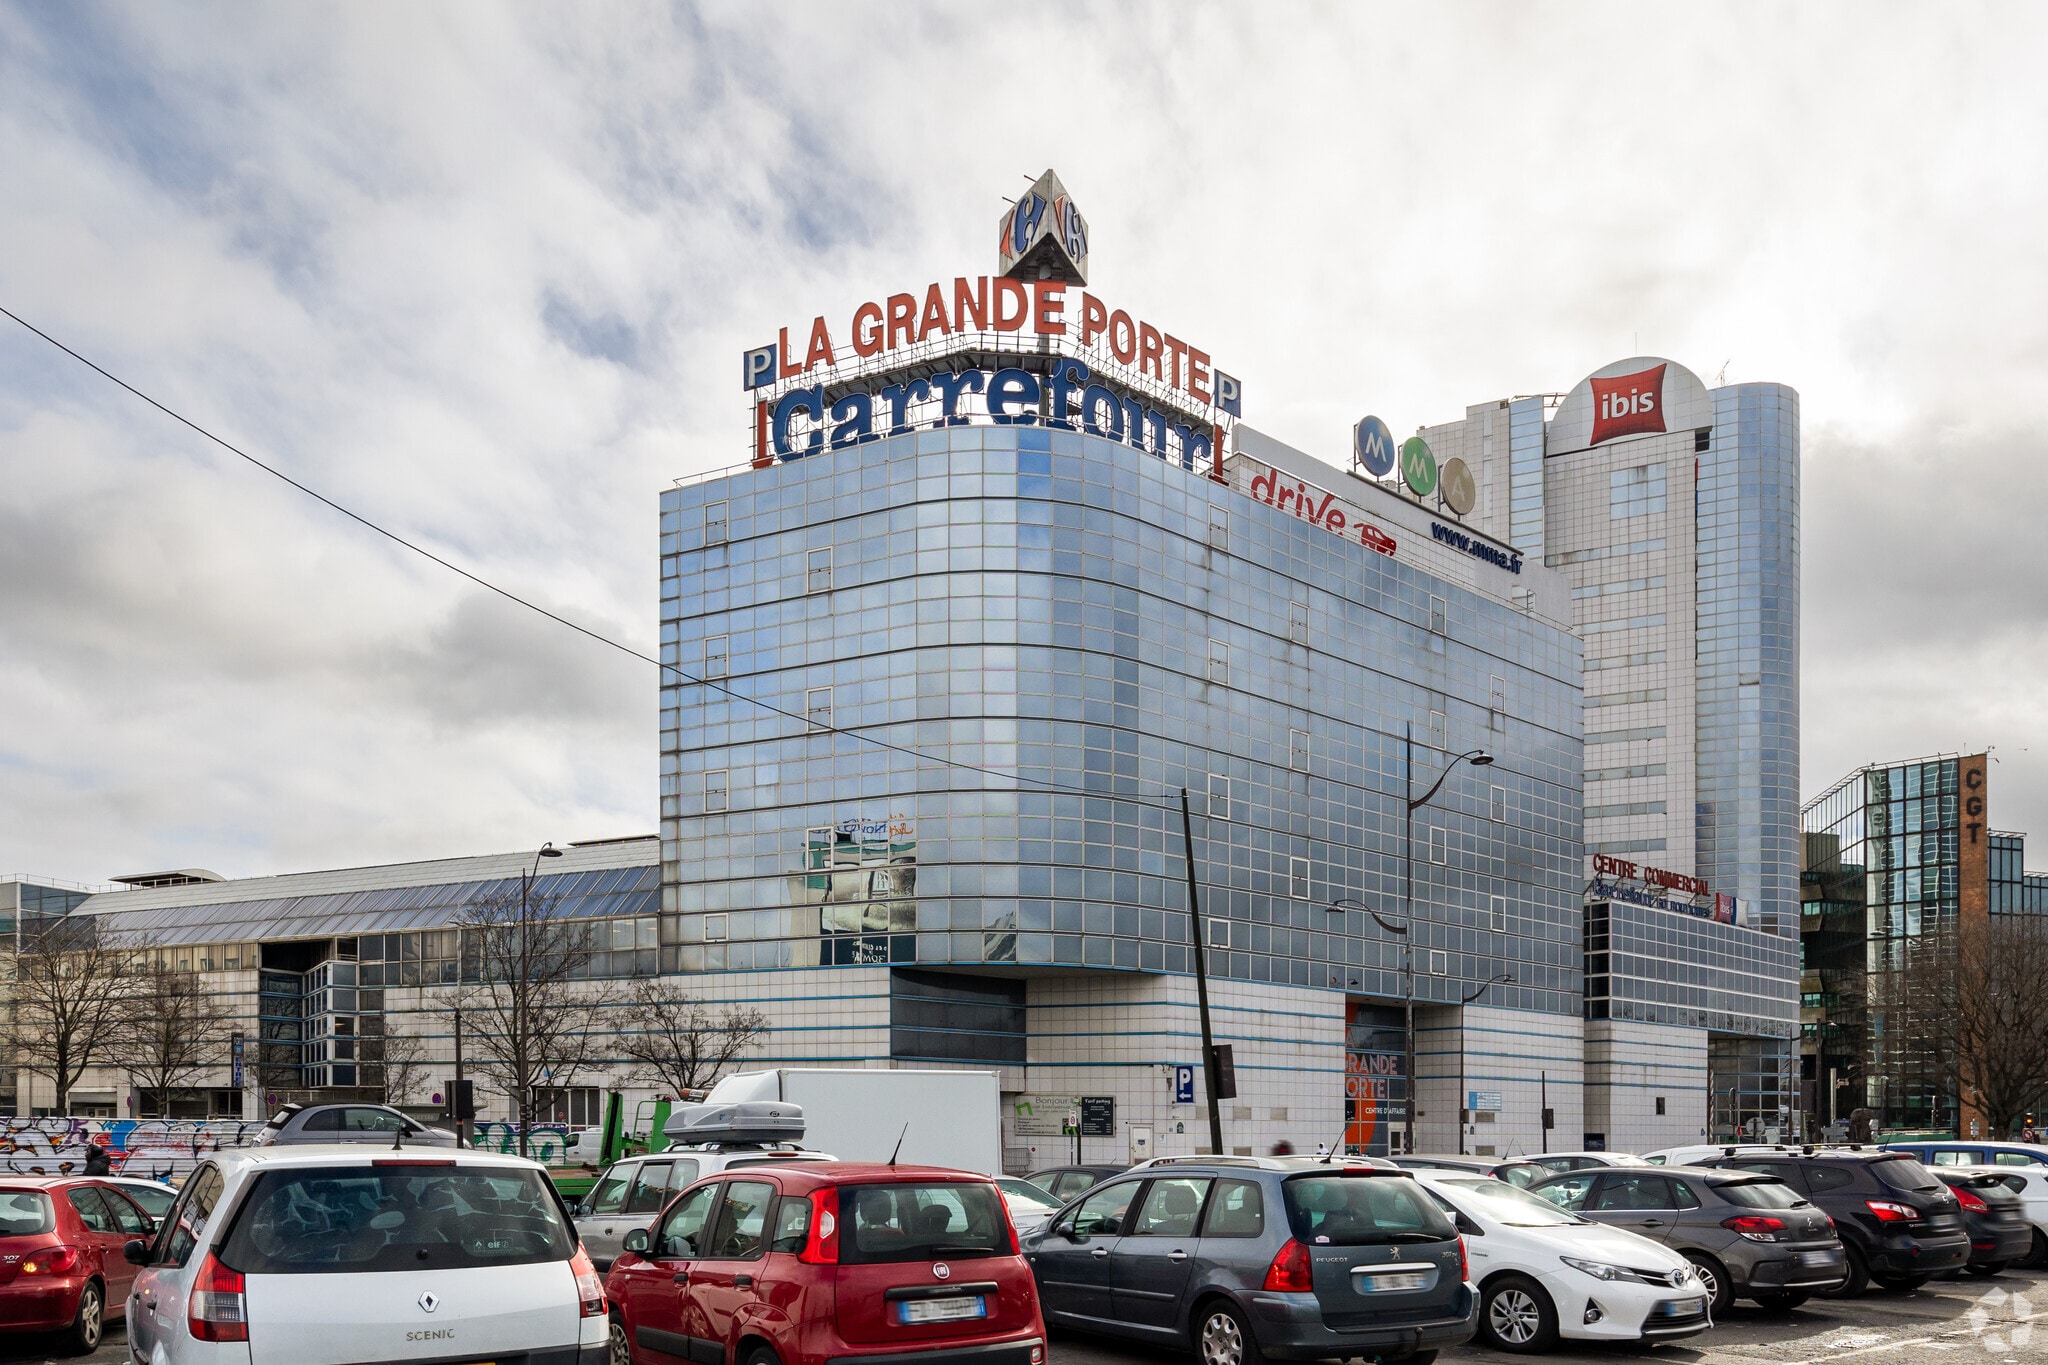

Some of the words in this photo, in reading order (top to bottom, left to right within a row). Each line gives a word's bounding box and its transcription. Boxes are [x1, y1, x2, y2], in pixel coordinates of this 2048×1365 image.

[779, 316, 836, 379] LA
[852, 276, 1066, 358] GRANDE
[1082, 291, 1212, 402] PORTE
[748, 349, 771, 386] P
[1222, 376, 1238, 407] P
[1602, 388, 1654, 420] ibis
[772, 357, 1212, 472] Carrefour
[1250, 469, 1346, 536] drive
[1431, 522, 1523, 575] www.mma.fr
[1593, 853, 1638, 880] CENTRE
[1644, 866, 1711, 897] COMMERCIAL
[1179, 1068, 1191, 1091] P
[1345, 1052, 1398, 1075] RANDE
[1035, 1097, 1068, 1105] Bonjour
[1346, 1077, 1386, 1098] ORTE
[406, 1328, 455, 1341] SCENIC
